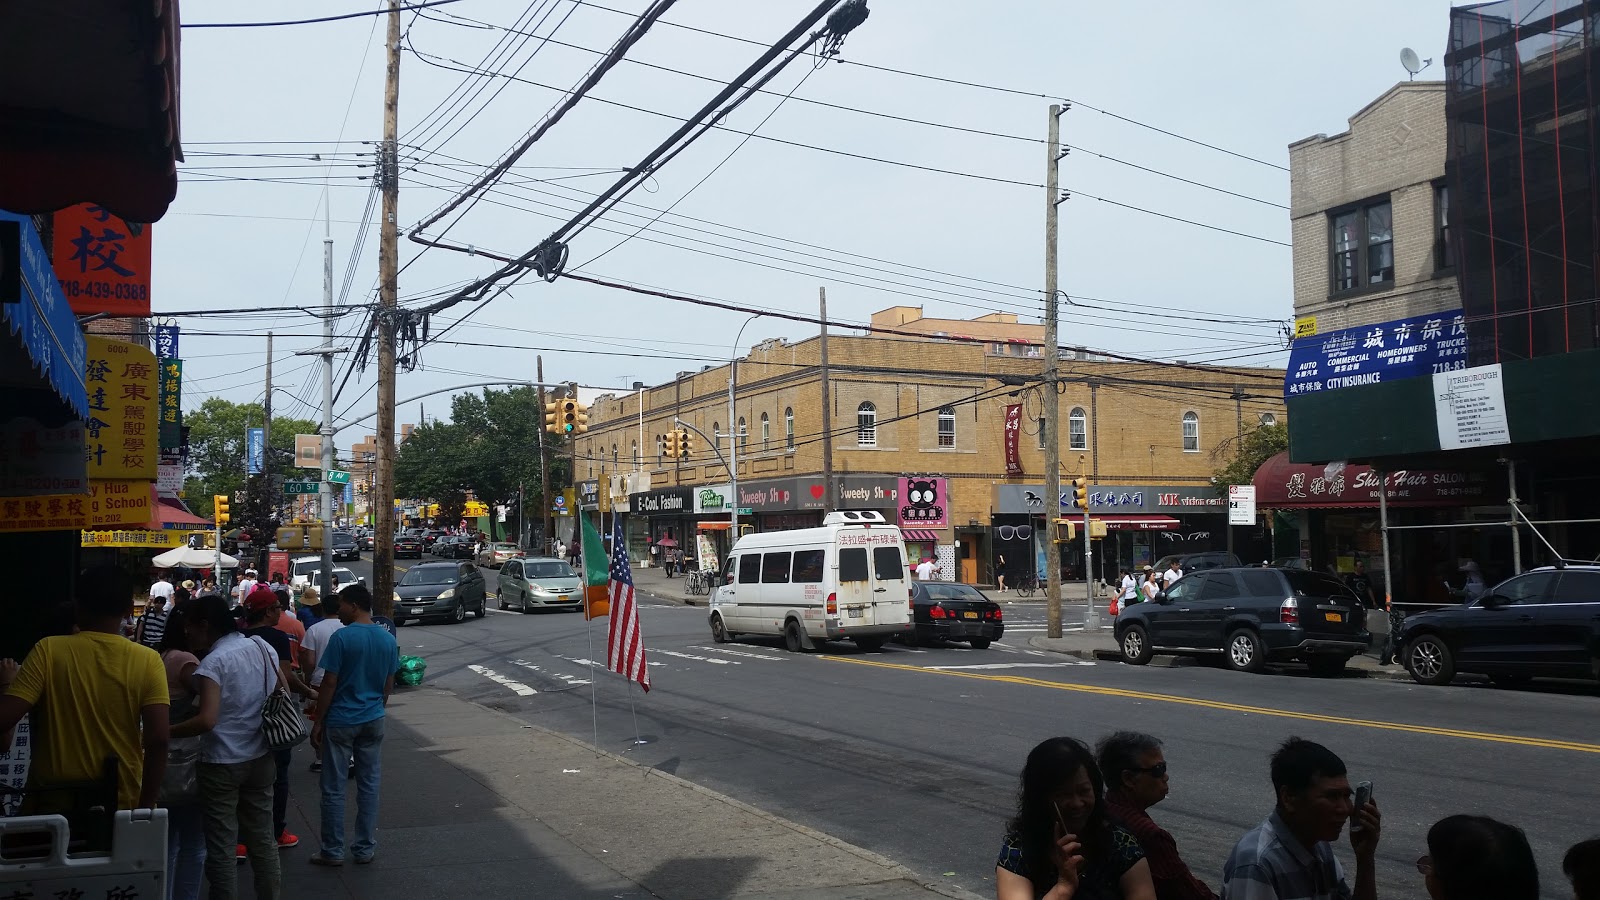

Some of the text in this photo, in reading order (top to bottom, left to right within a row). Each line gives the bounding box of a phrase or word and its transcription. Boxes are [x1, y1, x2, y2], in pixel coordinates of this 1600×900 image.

[58, 280, 147, 300] 718-439-0388
[107, 344, 129, 354] 6004
[1377, 343, 1428, 359] HOMEOWNERS
[1299, 361, 1317, 371] AUTO
[1327, 353, 1370, 366] COMMERCIAL
[1327, 371, 1381, 390] CITY INSURANCE
[1452, 371, 1498, 384] TRIBOROUGH
[120, 362, 152, 468] 廣東駕駛學校
[328, 471, 333, 480] 8
[1393, 470, 1427, 487] Hair
[1433, 472, 1465, 484] SALON
[104, 482, 129, 493] Hua
[289, 483, 302, 492] 60
[840, 484, 870, 501] Sweety
[1369, 490, 1381, 498] 600
[106, 496, 147, 509] School
[660, 494, 683, 509] Fashion
[740, 488, 766, 505] Sweety
[1158, 493, 1181, 506] MK
[1181, 496, 1205, 506] vision
[47, 519, 72, 527] SCHOOL
[104, 513, 121, 522] 202
